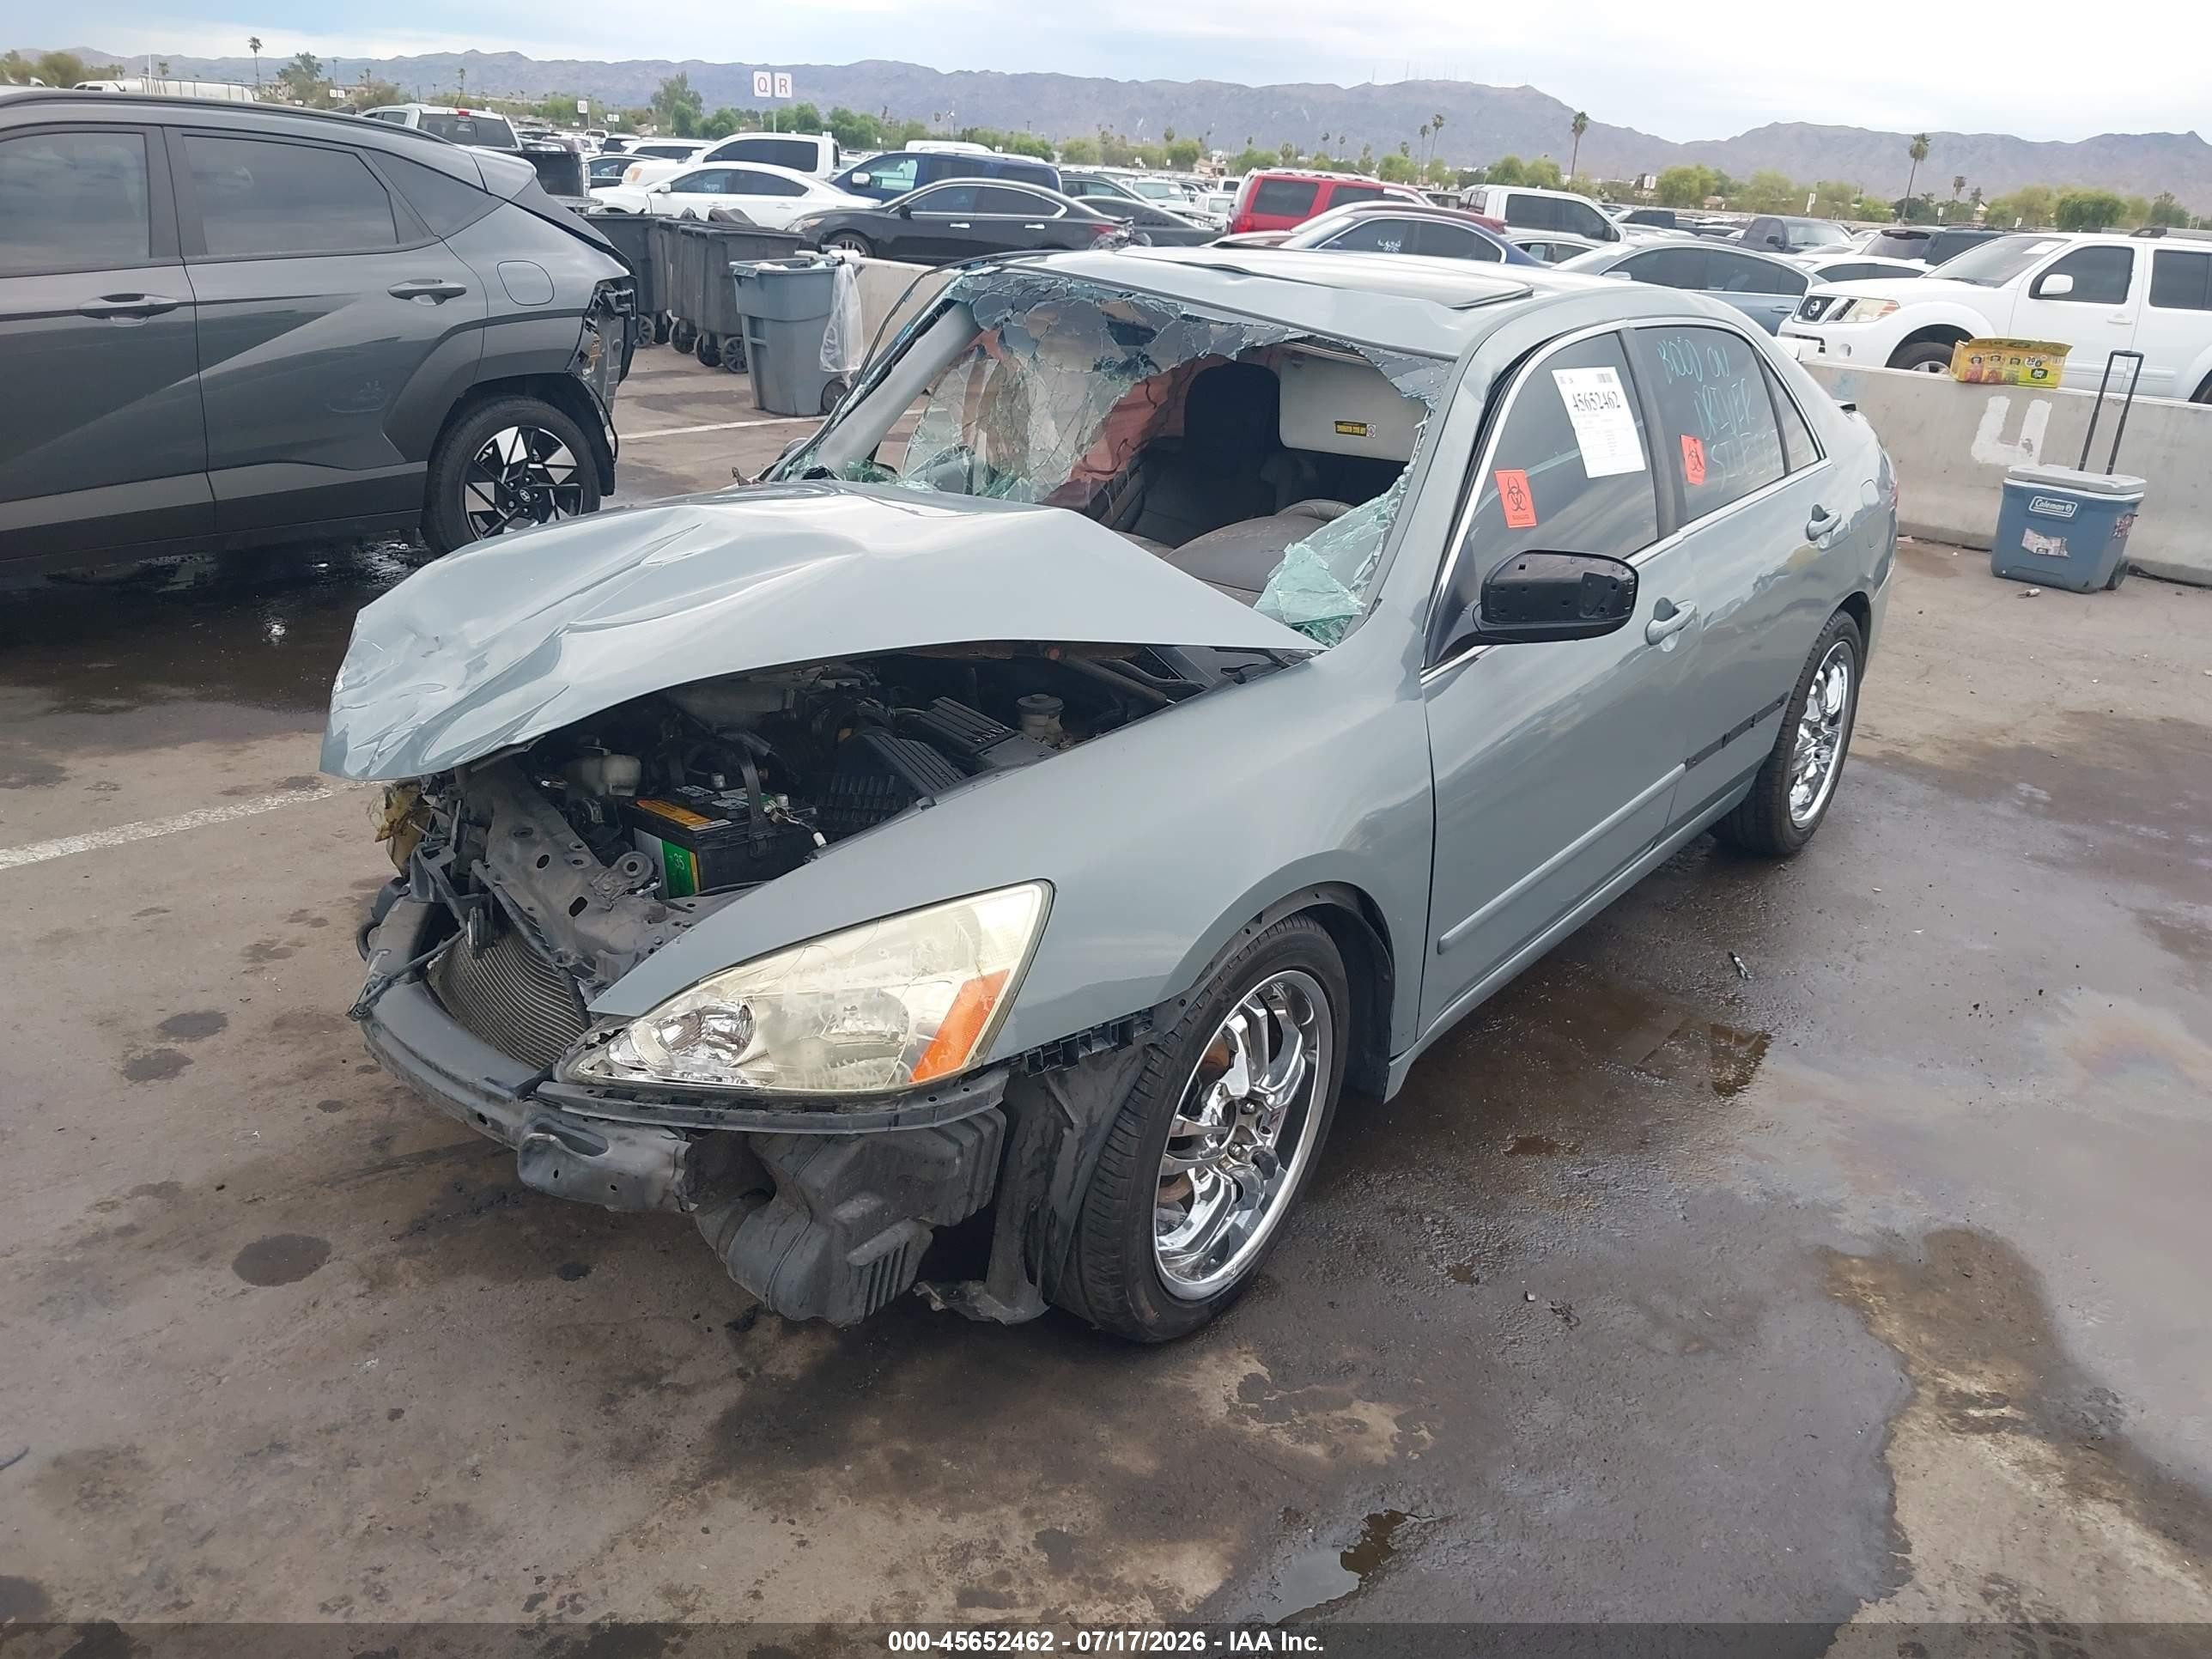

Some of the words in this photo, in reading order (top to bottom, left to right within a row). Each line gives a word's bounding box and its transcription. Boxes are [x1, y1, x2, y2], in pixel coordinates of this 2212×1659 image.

[757, 76, 769, 94] Q
[778, 77, 788, 94] R
[1571, 391, 1621, 412] 45652462
[2035, 498, 2066, 512] Coleman
